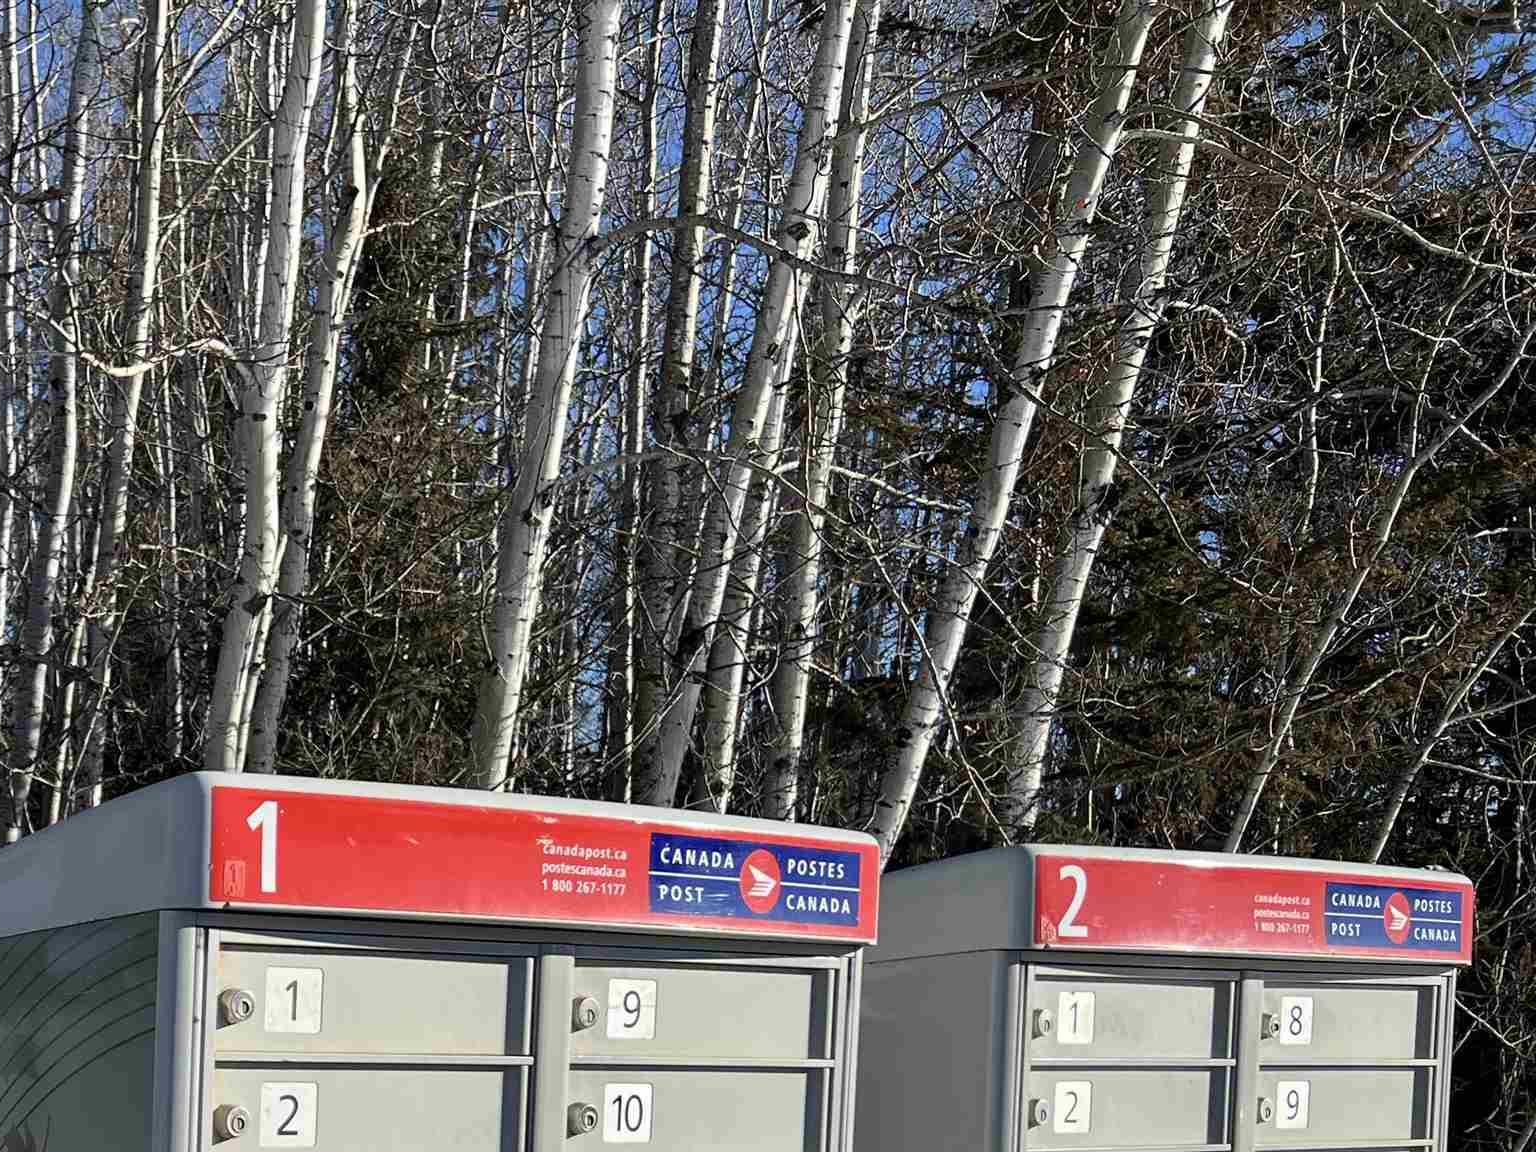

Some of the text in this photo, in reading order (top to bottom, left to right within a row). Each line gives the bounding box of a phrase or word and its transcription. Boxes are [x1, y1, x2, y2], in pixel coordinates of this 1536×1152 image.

[246, 800, 278, 893] 1
[542, 843, 628, 860] canadapost.ca
[660, 847, 735, 869] CANADA
[787, 859, 845, 879] POSTES
[541, 863, 627, 877] postescanada.ca
[542, 878, 626, 896] 1 800 267-1177
[659, 884, 705, 904] POST
[786, 894, 851, 915] CANADA
[1057, 865, 1088, 937] 2
[1331, 893, 1381, 909] CANADA
[1414, 899, 1453, 914] POSTES
[1331, 922, 1362, 937] POST
[1414, 927, 1457, 943] CANADA
[285, 979, 298, 1022] 1
[623, 990, 642, 1029] 9
[1069, 1001, 1078, 1034] 1
[1288, 1005, 1303, 1037] 8
[276, 1094, 299, 1136] 2
[612, 1094, 644, 1133] 10
[1063, 1090, 1078, 1124] 2
[1286, 1089, 1300, 1121] 9
